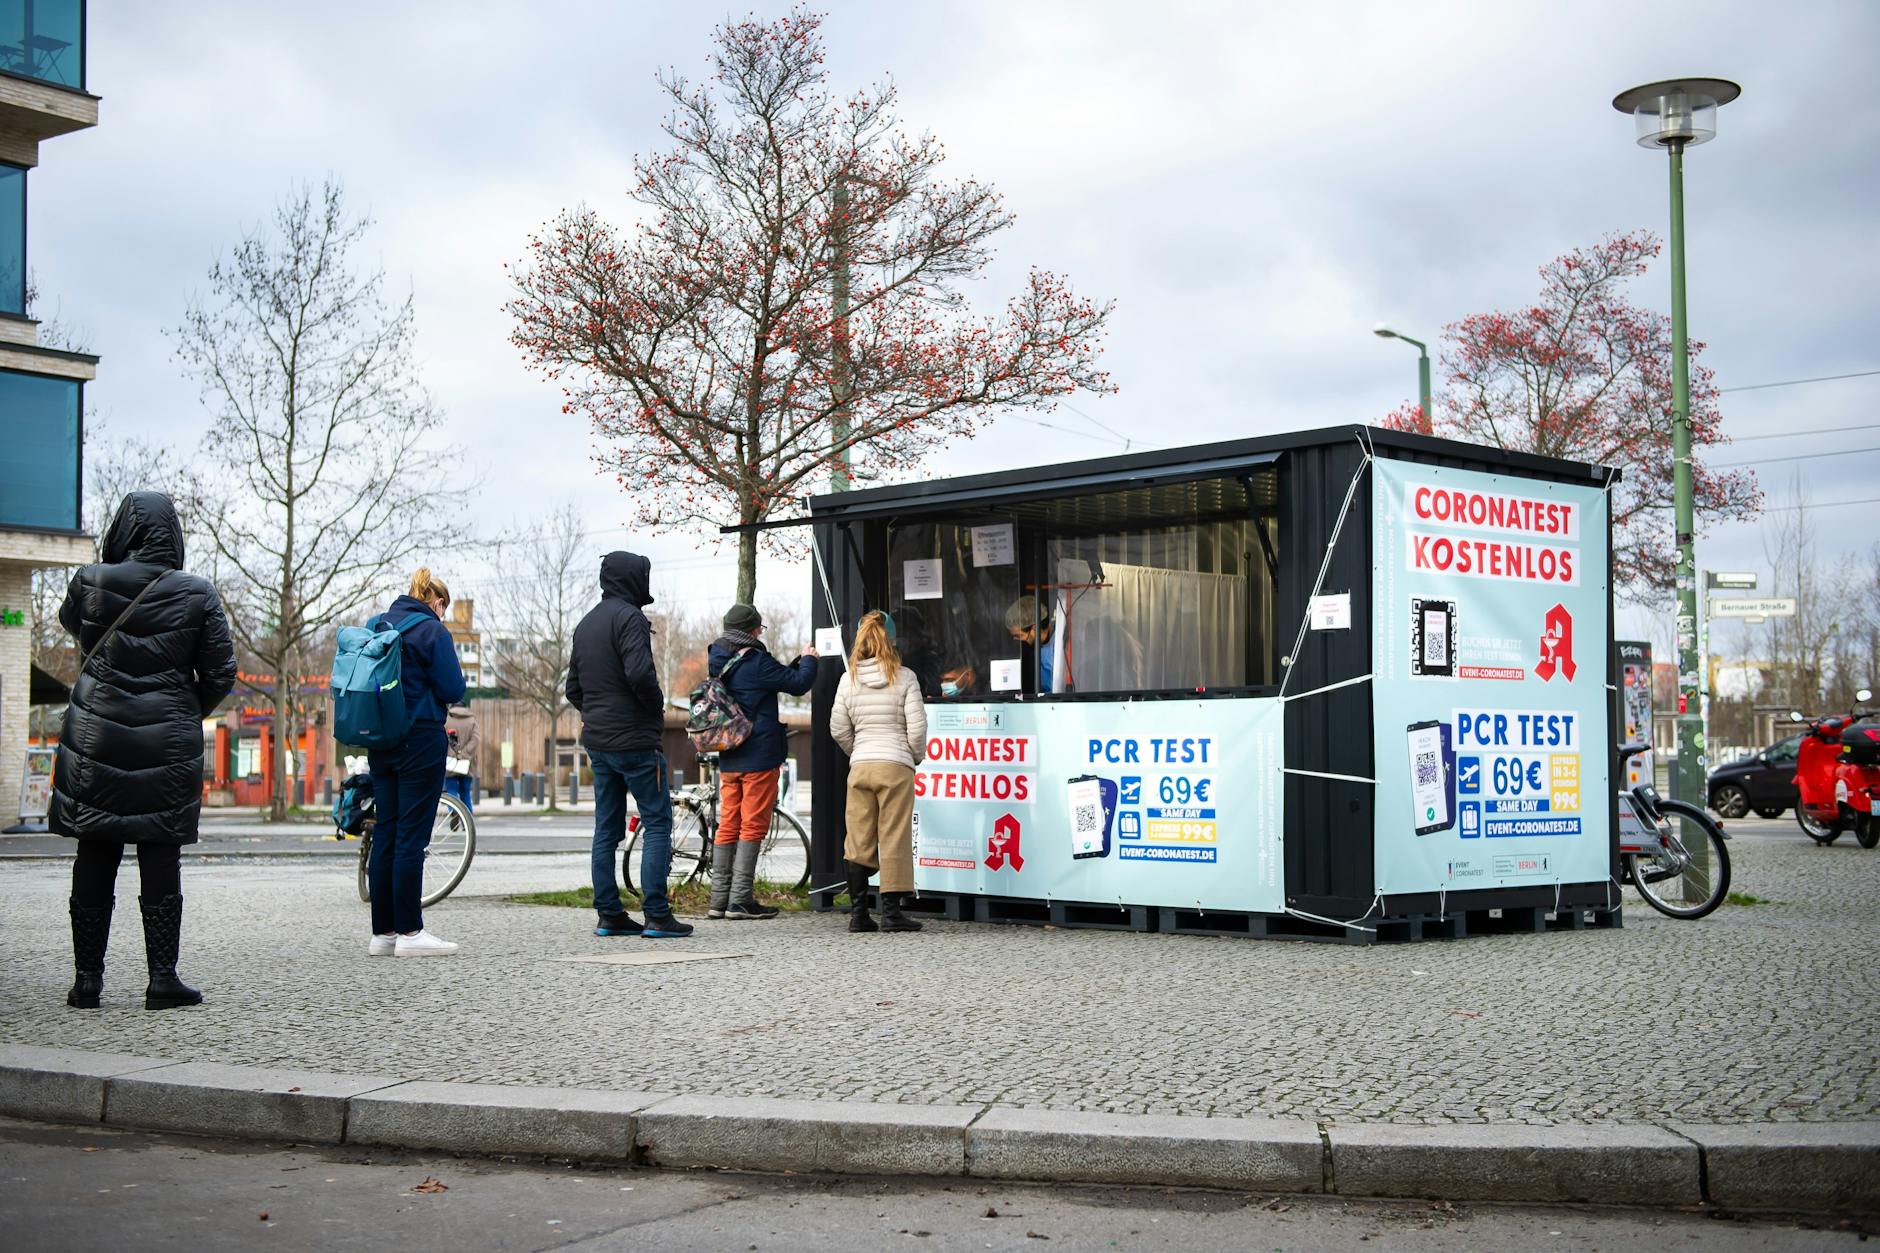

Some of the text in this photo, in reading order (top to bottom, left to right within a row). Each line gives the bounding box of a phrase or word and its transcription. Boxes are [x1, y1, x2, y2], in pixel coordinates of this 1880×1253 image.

[1414, 487, 1572, 535] CORONATEST
[1413, 535, 1573, 583] KOSTENLOS
[1721, 602, 1787, 611] Bernauer Straße
[1461, 668, 1523, 679] EVENT-CORONATEST.DE
[1458, 713, 1574, 746] PCR TEST
[926, 737, 1028, 762] ONATEST
[1088, 738, 1211, 763] PCR TEST
[1493, 757, 1542, 795] 69€
[914, 772, 1028, 801] STENLOS
[1159, 776, 1211, 804] 69€
[1496, 800, 1539, 812] SAME DAY
[1553, 792, 1578, 809] 99€
[1160, 808, 1201, 818] SAME DAY
[1183, 824, 1213, 840] 99€
[1487, 820, 1579, 835] EVENT-CORONATEST.DE
[1121, 847, 1215, 860] EVENT-CORONATEST.DE
[1518, 861, 1538, 870] BERLIN
